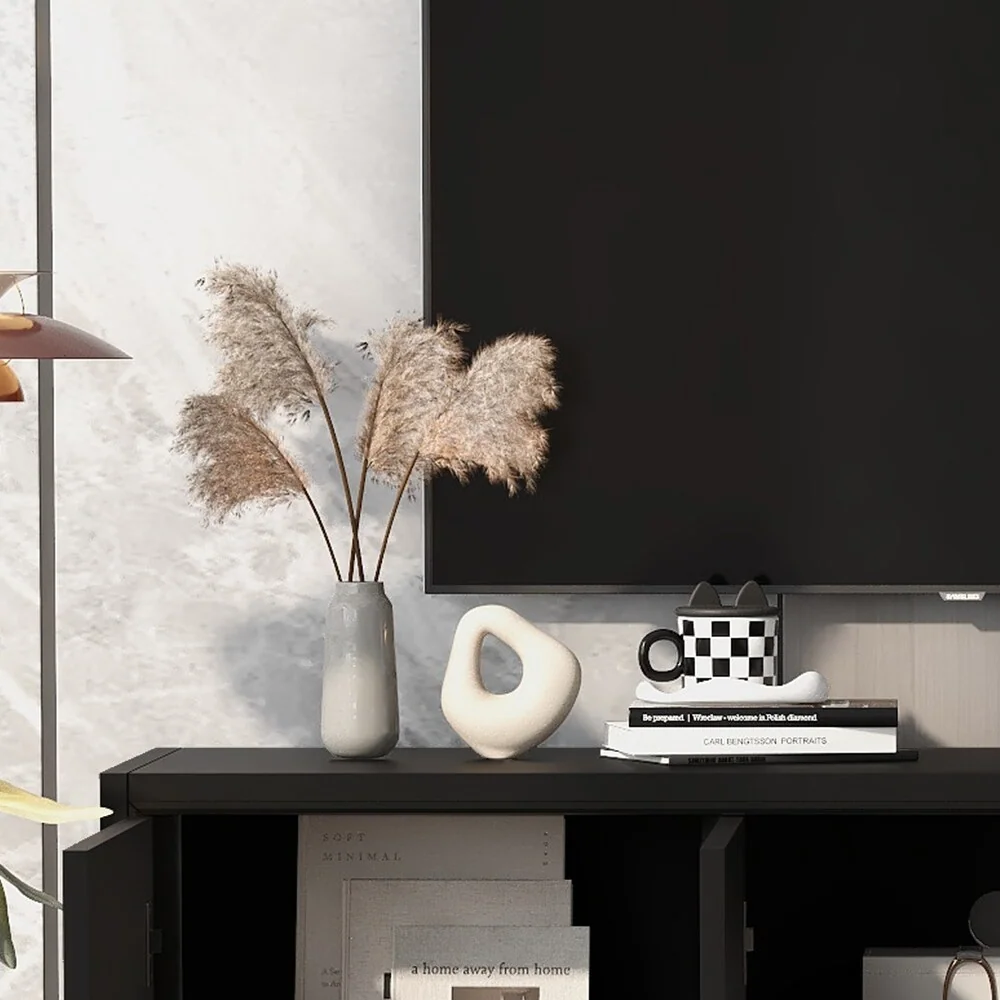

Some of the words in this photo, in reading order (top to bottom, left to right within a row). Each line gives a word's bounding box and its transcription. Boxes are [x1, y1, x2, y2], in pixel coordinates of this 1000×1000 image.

[643, 713, 653, 722] Be
[703, 738, 725, 746] CARL
[780, 737, 827, 745] PORTRAITS
[322, 832, 366, 842] SOFT
[322, 852, 402, 861] MINIMAL
[411, 965, 418, 975] a
[422, 962, 459, 975] home
[463, 965, 495, 978] away
[499, 962, 529, 975] from
[534, 963, 571, 975] home
